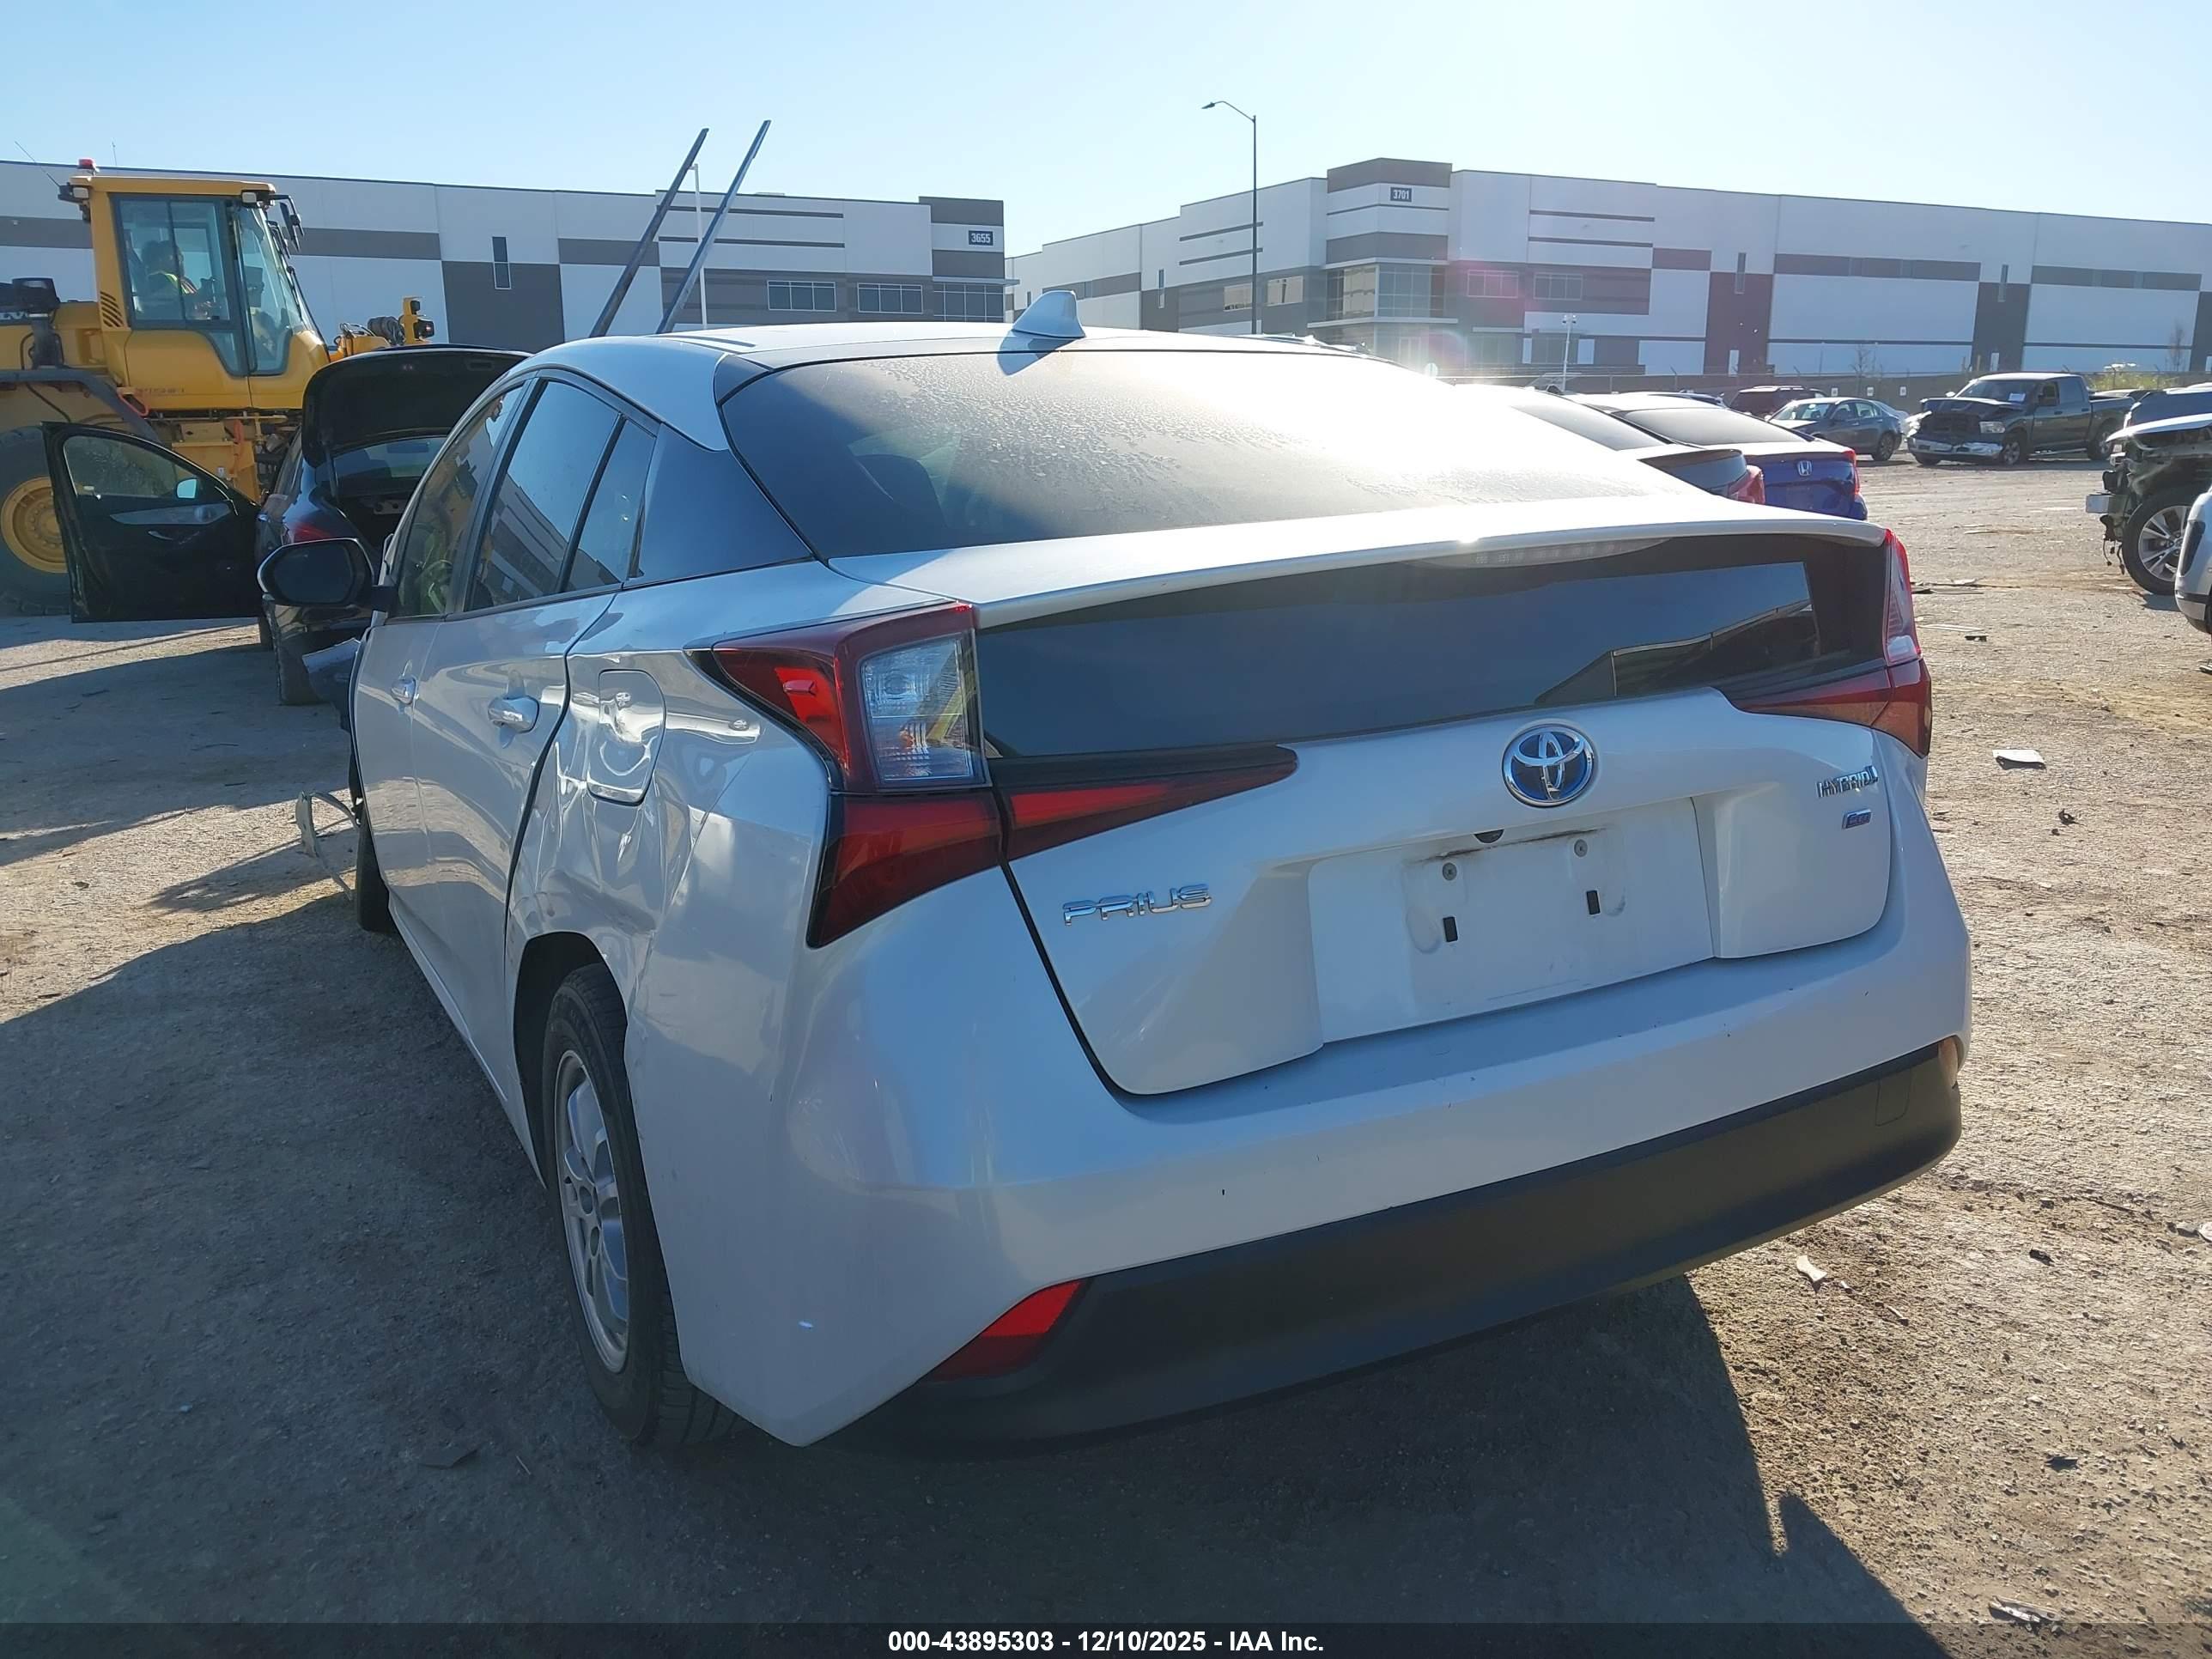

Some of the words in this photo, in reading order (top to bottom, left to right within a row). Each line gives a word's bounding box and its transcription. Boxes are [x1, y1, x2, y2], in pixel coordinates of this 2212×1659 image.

[1393, 189, 1409, 200] 3701
[970, 233, 991, 244] 3655
[1816, 765, 1878, 797] HYBRID
[1063, 884, 1212, 926] PRIUS
